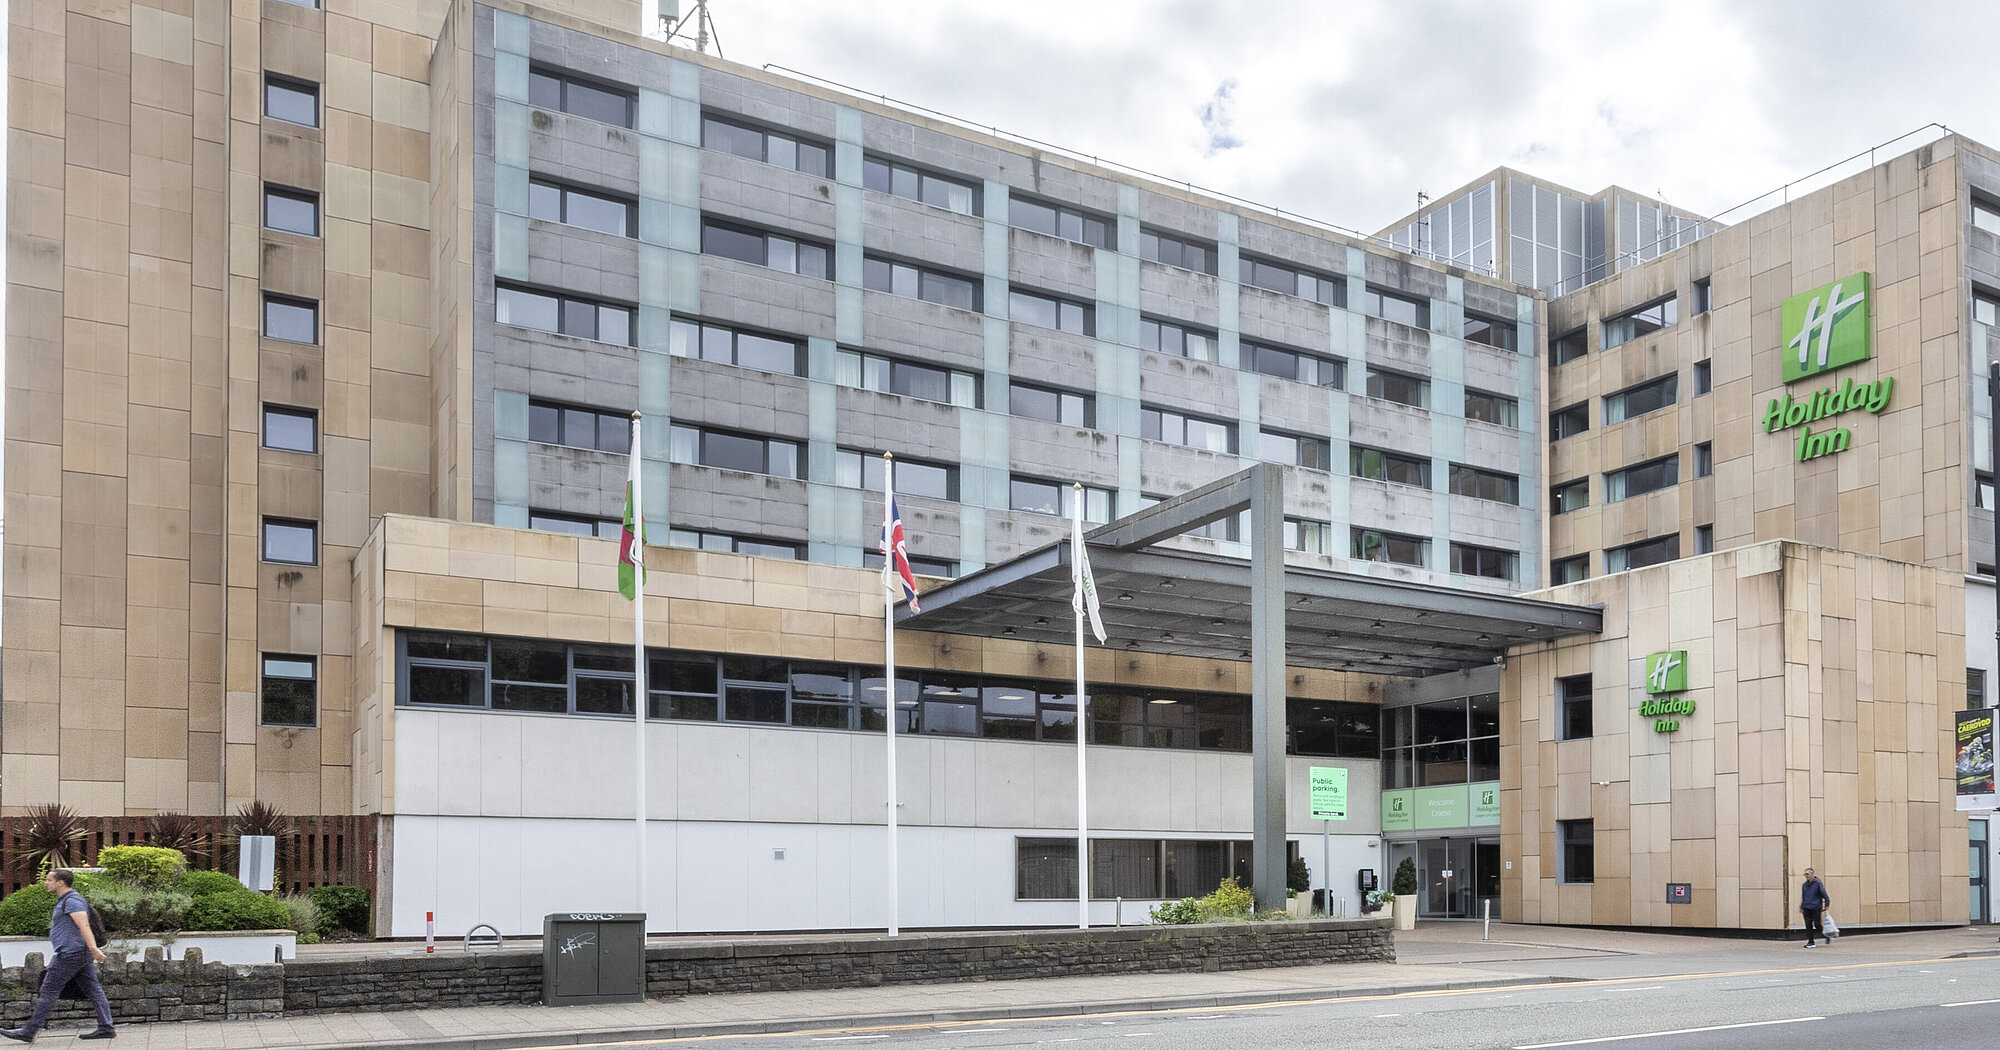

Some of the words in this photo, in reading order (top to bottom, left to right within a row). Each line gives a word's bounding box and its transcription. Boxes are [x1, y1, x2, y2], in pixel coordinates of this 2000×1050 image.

[1762, 377, 1894, 433] Holiday
[1796, 426, 1851, 462] Inn
[1638, 696, 1696, 717] Holiday
[1653, 718, 1679, 733] Inn
[1312, 785, 1340, 793] parking.
[1428, 799, 1455, 807] Welcome
